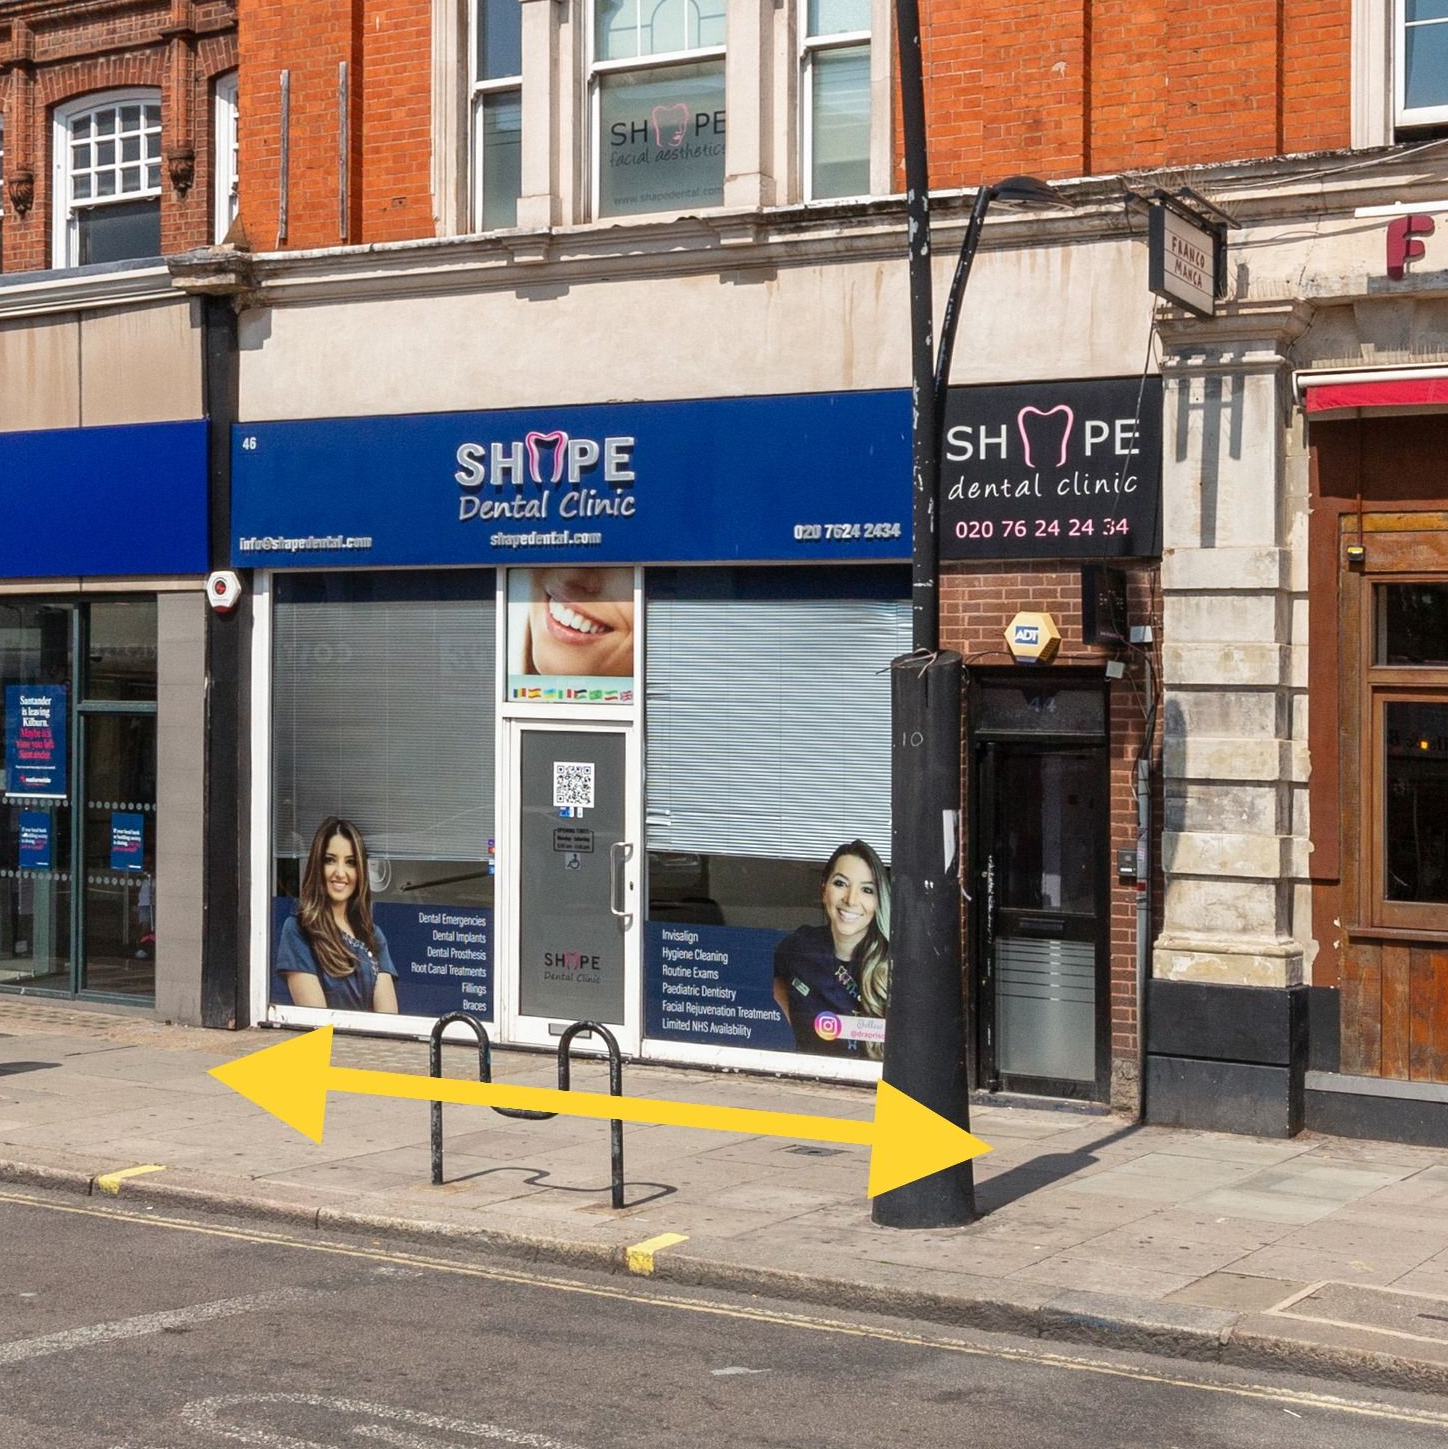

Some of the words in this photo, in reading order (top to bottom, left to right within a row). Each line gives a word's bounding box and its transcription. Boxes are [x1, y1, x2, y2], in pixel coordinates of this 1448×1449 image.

[1172, 236, 1206, 269] FRANCO
[1175, 258, 1203, 289] MANCA
[242, 437, 257, 450] 46
[948, 472, 1042, 500] dental
[1057, 470, 1138, 496] clinic
[458, 489, 550, 521] Dental
[559, 488, 636, 519] Clinic
[793, 523, 822, 540] 020
[823, 522, 861, 540] 7624
[863, 521, 902, 539] 2434
[955, 520, 994, 539] 020
[1001, 519, 1027, 538] 76
[1034, 519, 1061, 537] 24
[1067, 517, 1095, 536] 24
[1102, 517, 1130, 536] 34
[238, 535, 374, 553] info@shapedental.com
[490, 530, 603, 549] shapedental.com
[1015, 628, 1038, 643] ADT
[19, 695, 52, 706] Santander
[21, 707, 28, 716] is
[28, 706, 51, 718] leaving
[22, 717, 50, 727] Kilburn.
[418, 912, 441, 923] Dental
[442, 913, 487, 928] Emergencies
[432, 930, 455, 941] Dental
[456, 931, 487, 944] Implants
[662, 929, 699, 944] Invisalign
[427, 946, 450, 958] Dental
[450, 948, 487, 961] Prosthesis
[662, 947, 693, 961] Hygiene
[694, 948, 728, 965] Cleaning
[411, 962, 427, 973] Root
[428, 963, 448, 975] Canal
[449, 964, 487, 977] Treatments
[544, 971, 574, 982] Dental
[662, 964, 692, 978] Routine
[693, 967, 719, 980] Exams
[462, 982, 487, 996] Fillings
[662, 982, 700, 996] Paediatric
[701, 985, 737, 1002] Dentistry
[463, 999, 487, 1011] Braces
[662, 1000, 684, 1013] Facial
[686, 1002, 736, 1017] Rejuvenation
[737, 1006, 781, 1021] Treatments
[662, 1018, 691, 1031] Limited
[692, 1020, 709, 1033] NHS
[710, 1022, 752, 1039] Availability
